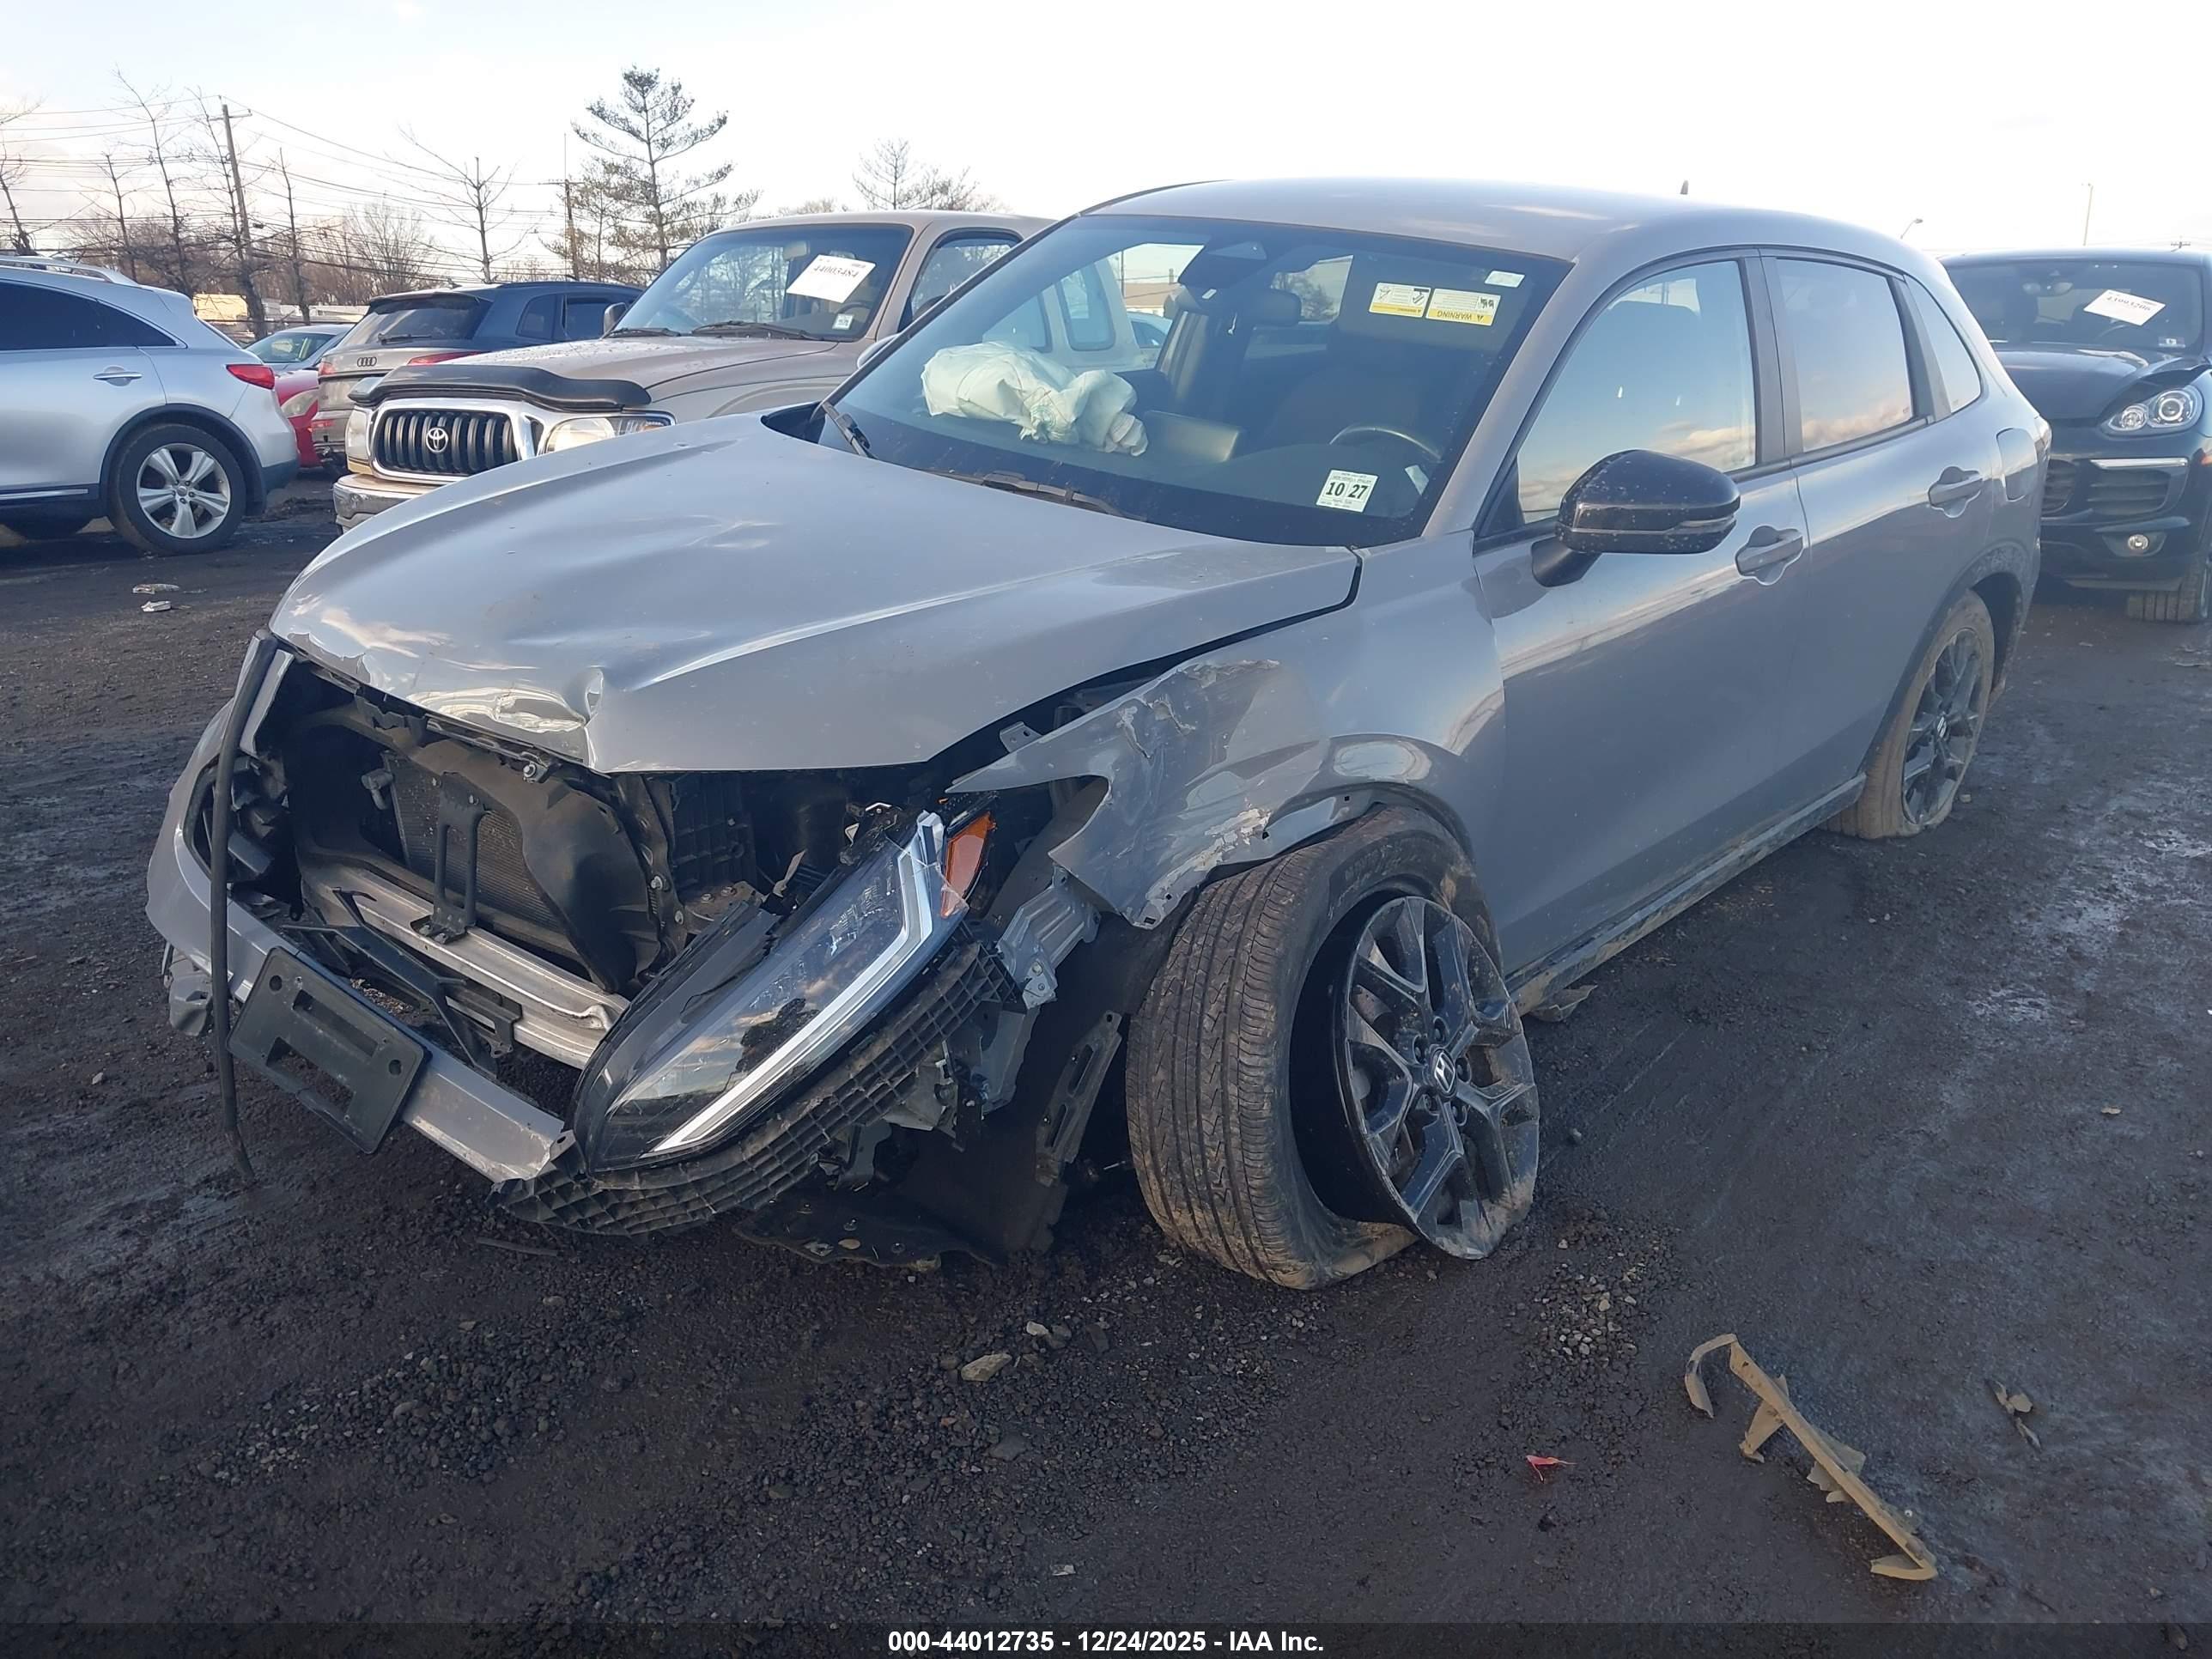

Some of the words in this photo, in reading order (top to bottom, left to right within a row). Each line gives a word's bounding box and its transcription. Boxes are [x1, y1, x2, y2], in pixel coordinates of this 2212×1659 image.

[1437, 310, 1472, 321] WARNING
[1326, 482, 1346, 496] 10
[1348, 483, 1369, 500] 27
